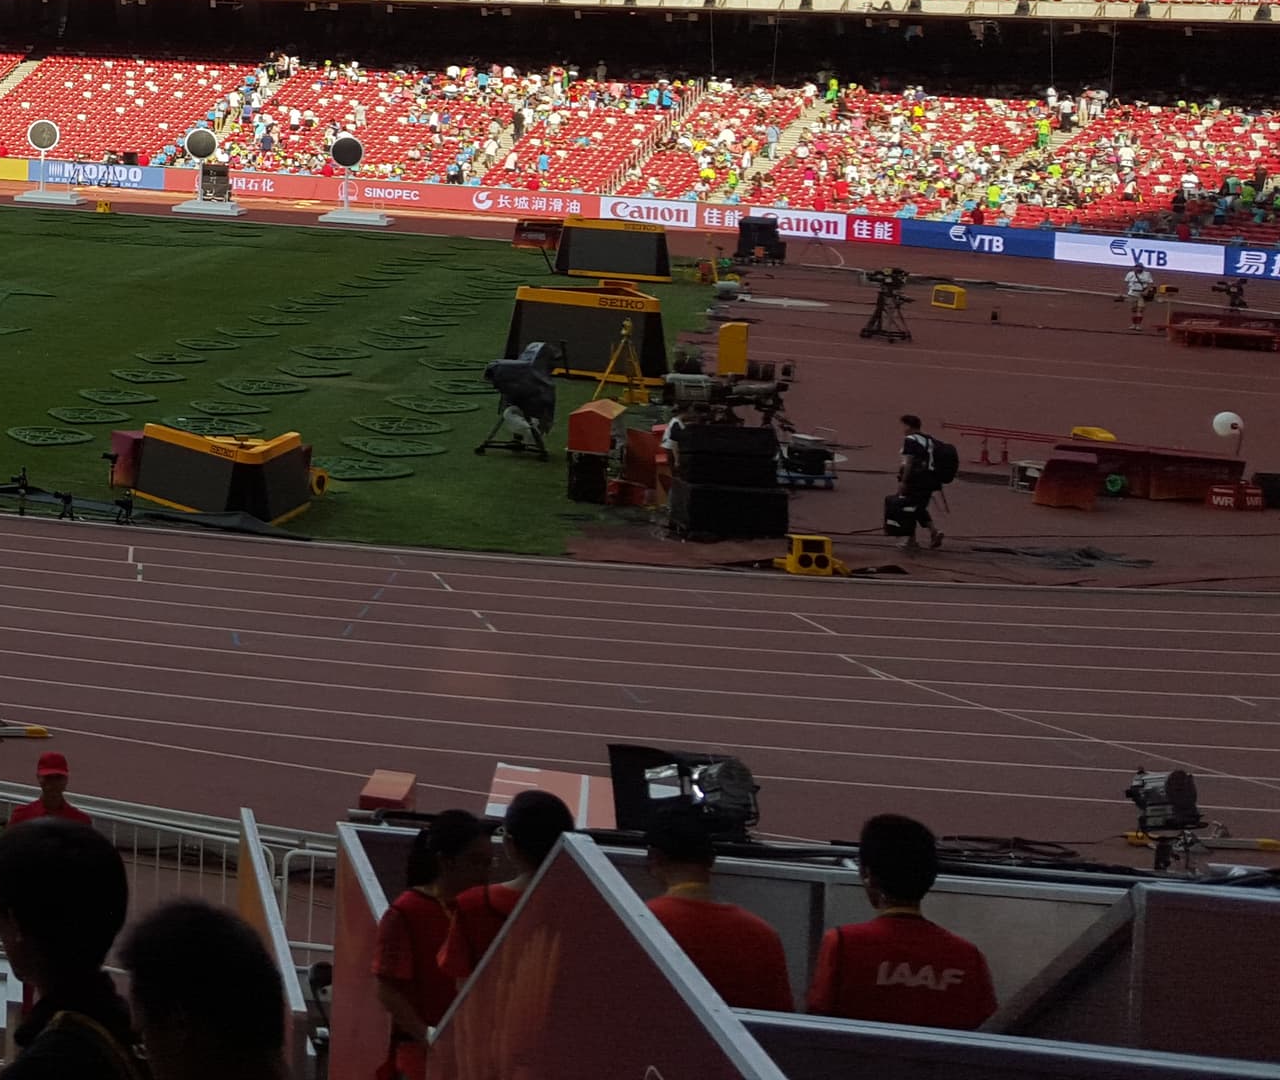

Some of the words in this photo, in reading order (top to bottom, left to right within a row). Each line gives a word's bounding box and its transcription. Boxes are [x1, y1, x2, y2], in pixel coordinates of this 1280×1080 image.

[64, 164, 142, 182] MONDO
[229, 177, 274, 192] 国石化
[364, 187, 420, 201] SINOPEC
[497, 194, 581, 213] 长城润滑油
[610, 201, 689, 223] Canon
[703, 207, 744, 227] 佳能
[762, 212, 838, 235] anon
[853, 219, 893, 240] 佳能
[968, 234, 1004, 252] VTB
[1131, 248, 1168, 266] VTB
[599, 297, 644, 310] SEIKO
[876, 960, 966, 992] IAAF
